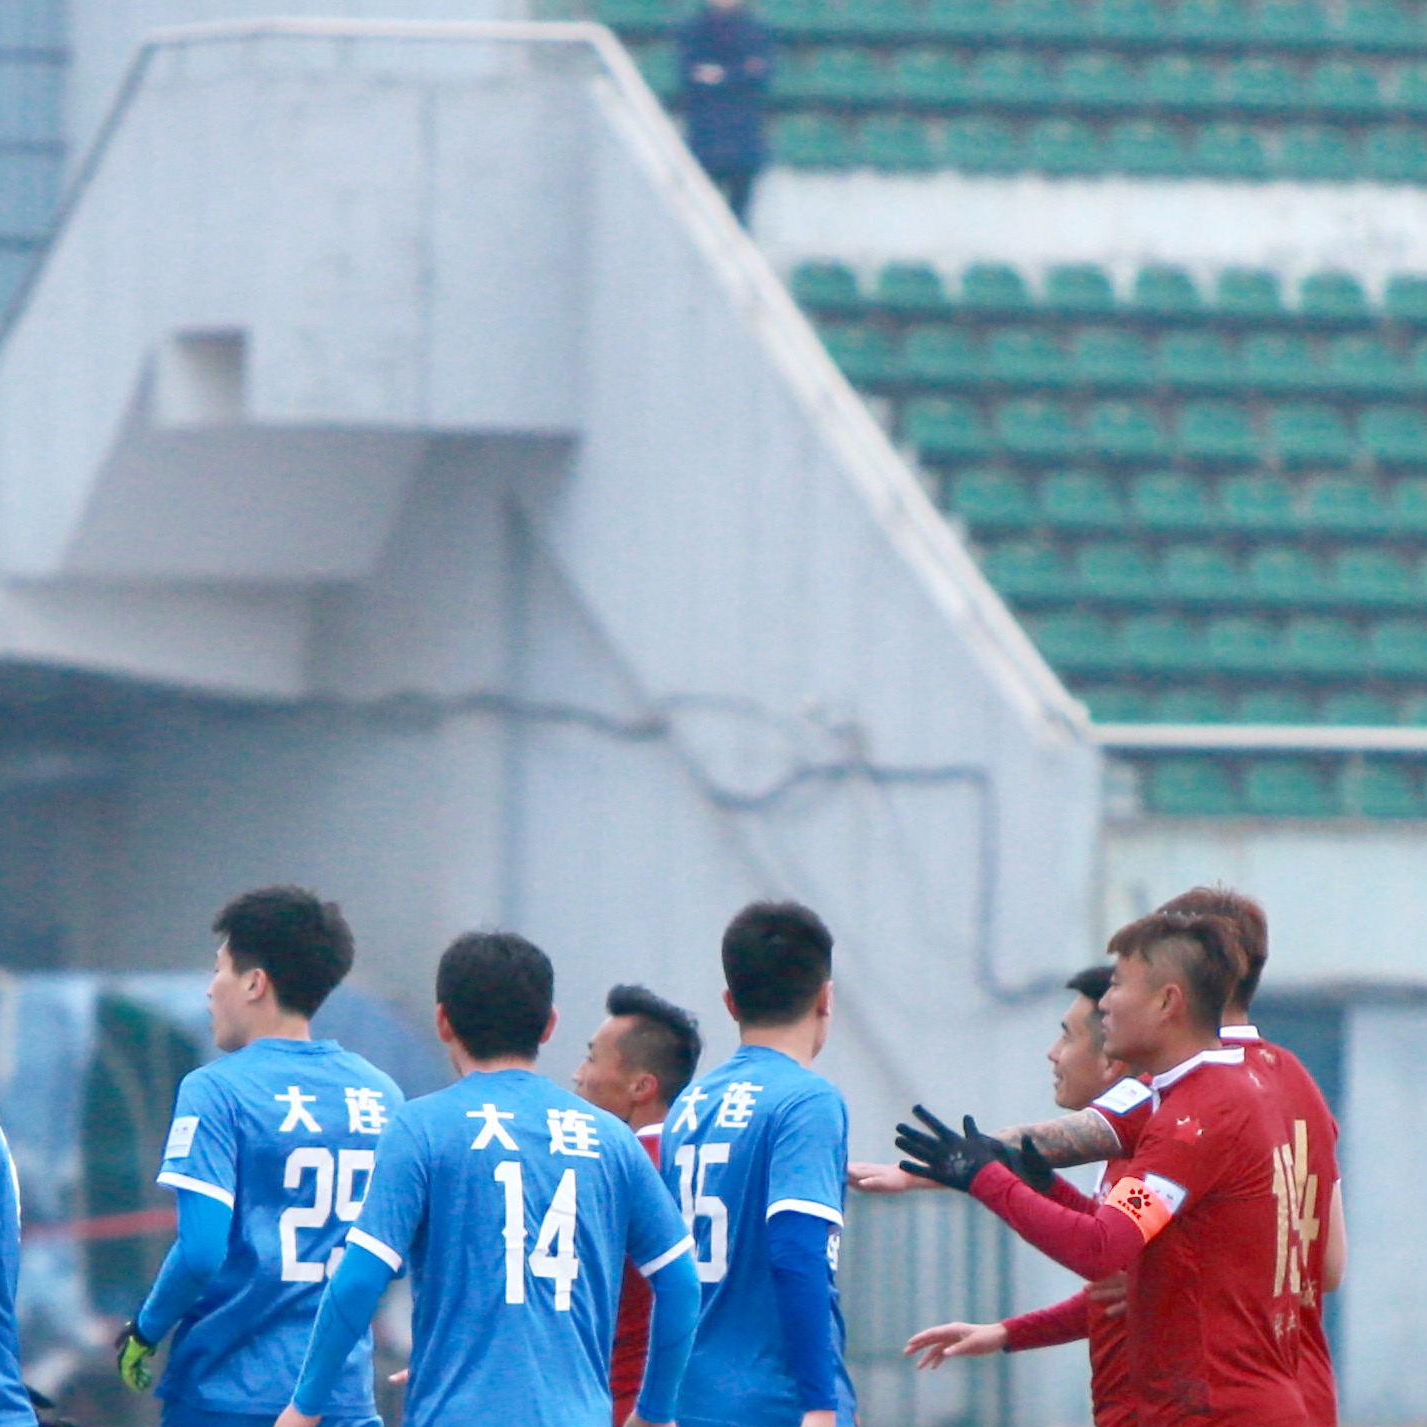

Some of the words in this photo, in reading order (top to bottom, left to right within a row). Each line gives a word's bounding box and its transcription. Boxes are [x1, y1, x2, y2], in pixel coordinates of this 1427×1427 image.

[274, 1086, 388, 1134] 大连
[466, 1103, 600, 1158] 大连
[671, 1081, 763, 1133] 大连
[494, 1161, 579, 1311] 14
[674, 1142, 730, 1283] 15
